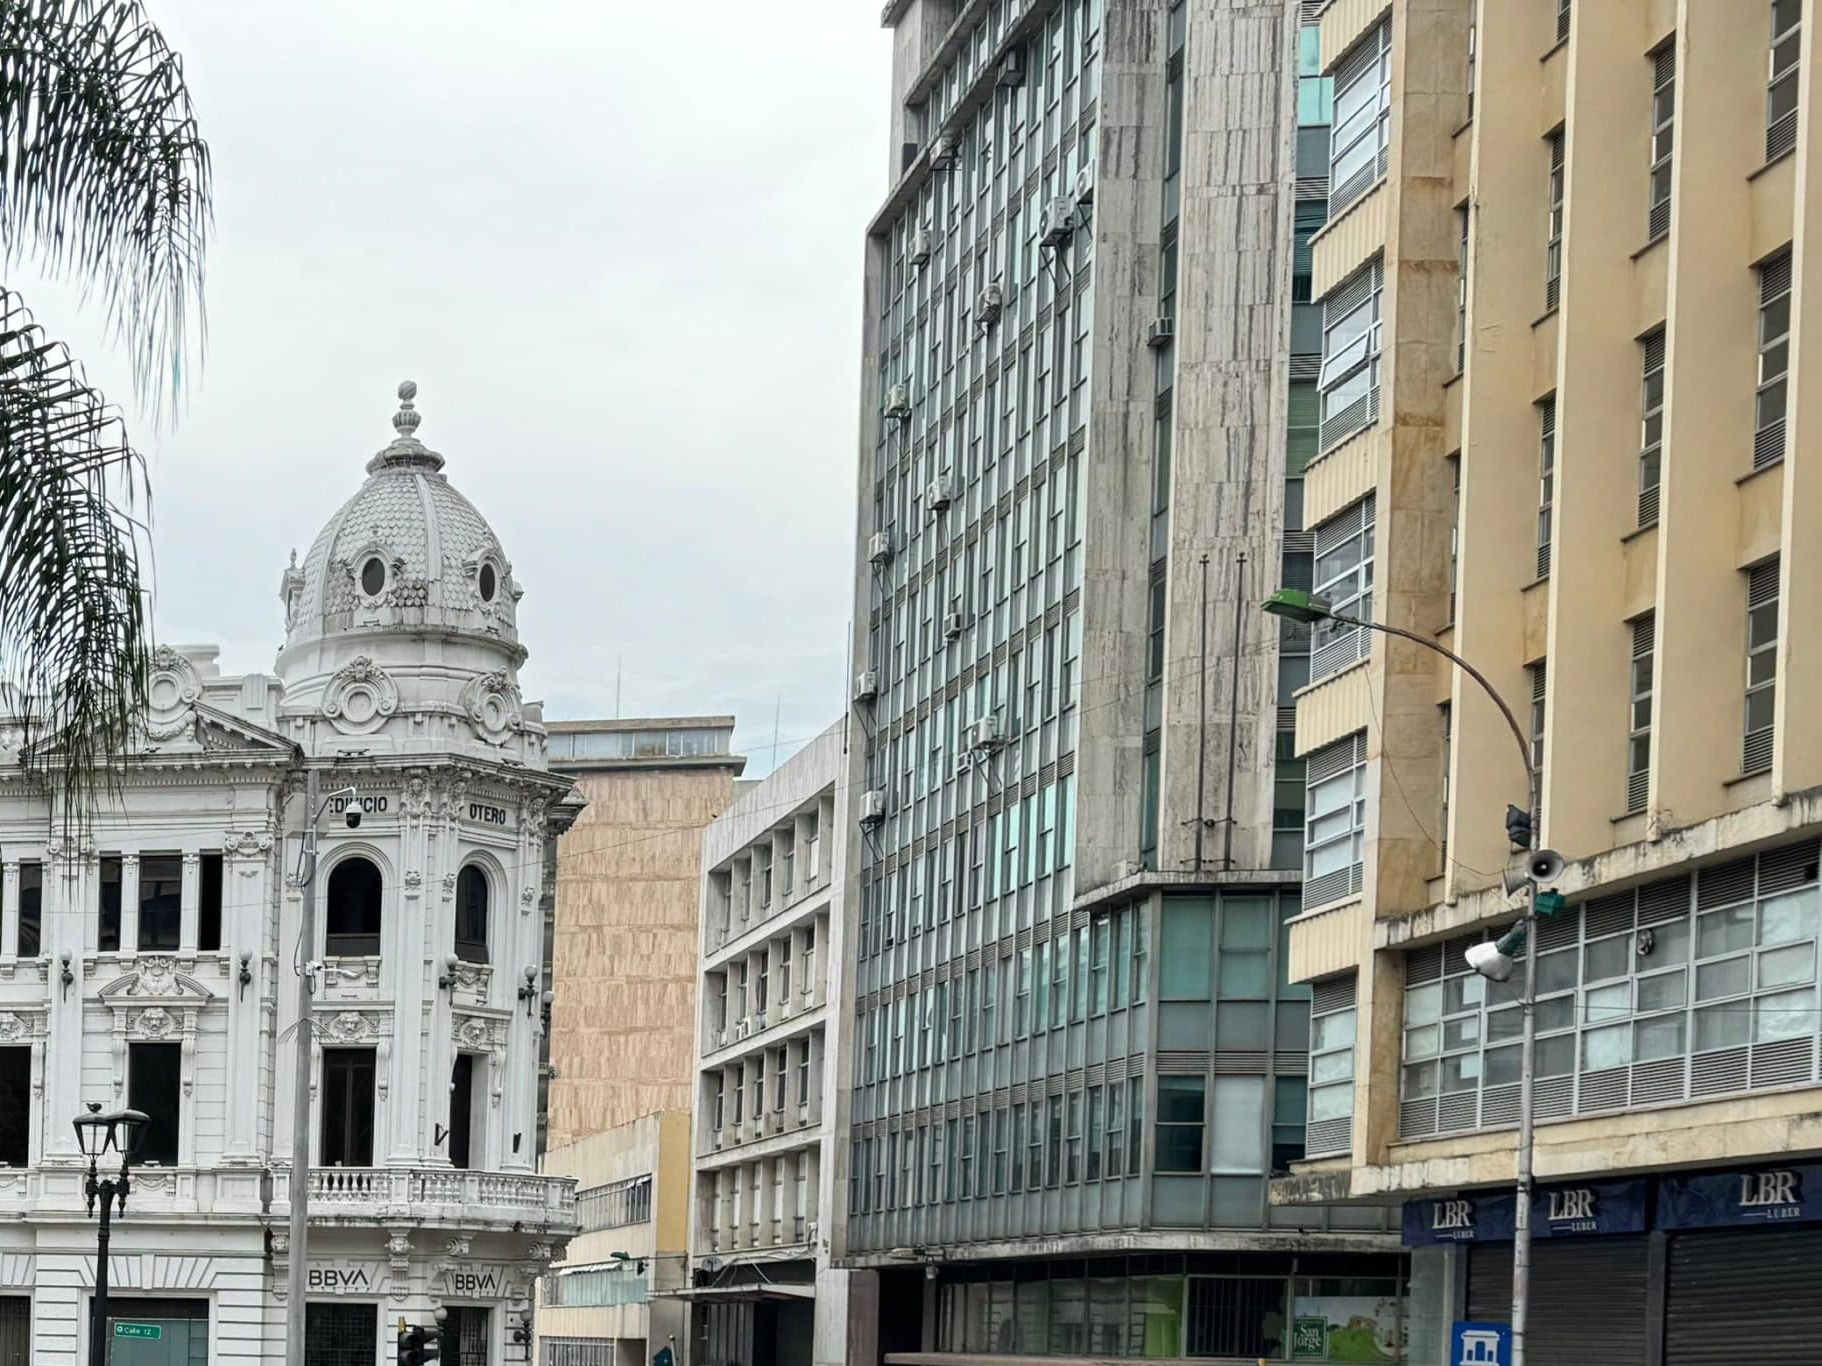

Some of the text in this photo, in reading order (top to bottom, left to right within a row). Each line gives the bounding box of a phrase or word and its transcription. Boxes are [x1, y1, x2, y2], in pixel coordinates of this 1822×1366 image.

[469, 803, 506, 825] OTERO
[1738, 1172, 1799, 1206] LBR
[1548, 1189, 1594, 1221] LBR
[1766, 1207, 1800, 1218] LUBER
[1432, 1200, 1472, 1229] LBR
[1571, 1221, 1597, 1232] LUBER
[308, 1269, 369, 1286] BBVA
[454, 1273, 496, 1290] BBVA
[1299, 1321, 1319, 1338] San
[1292, 1332, 1322, 1351] Jorge
